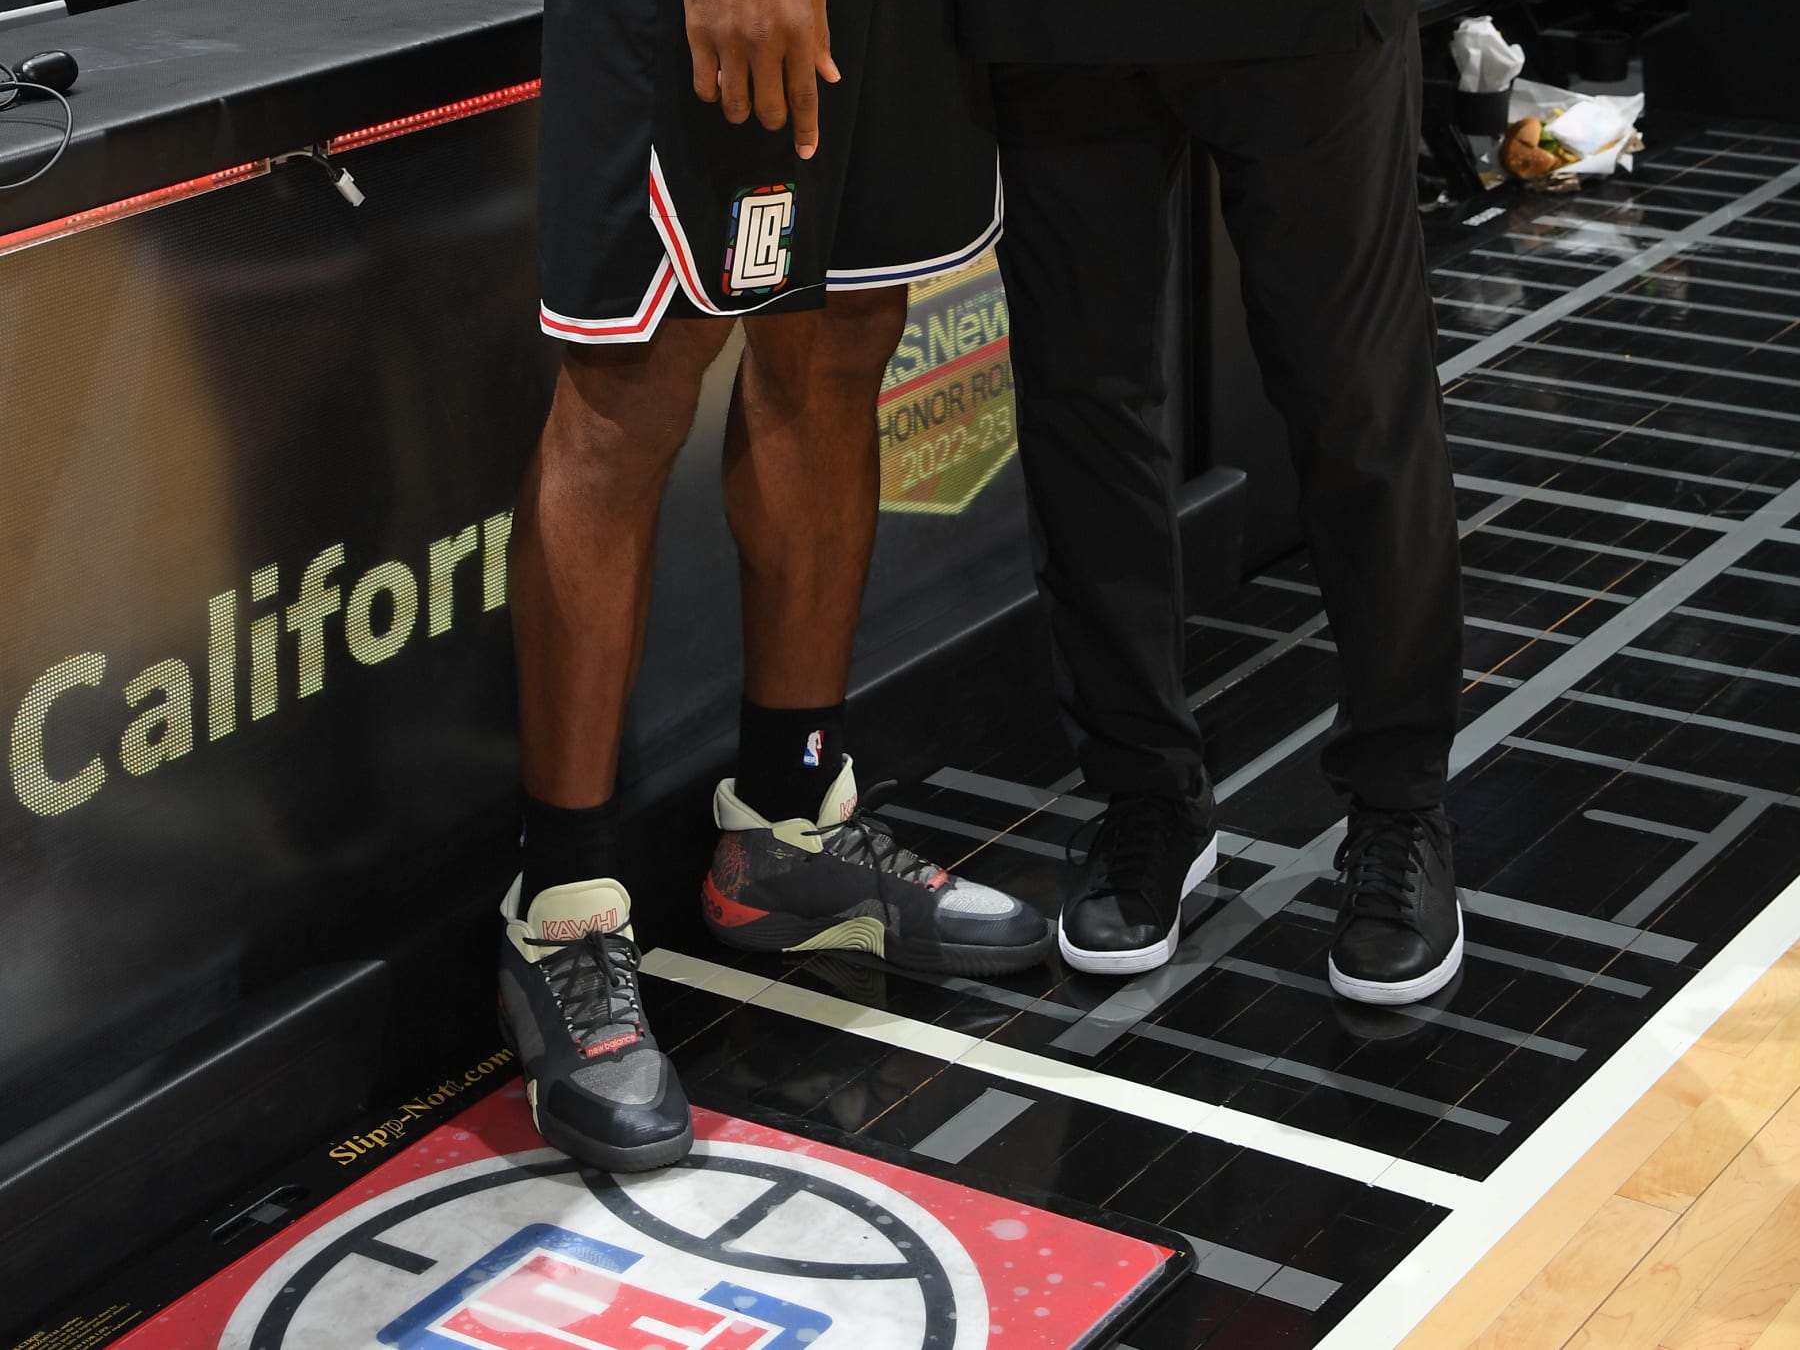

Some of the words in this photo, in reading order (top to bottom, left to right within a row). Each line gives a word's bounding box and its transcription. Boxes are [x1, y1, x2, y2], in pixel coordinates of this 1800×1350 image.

[879, 381, 964, 448] HONOR
[902, 404, 1012, 491] 2022-23
[542, 907, 618, 941] KAWHI
